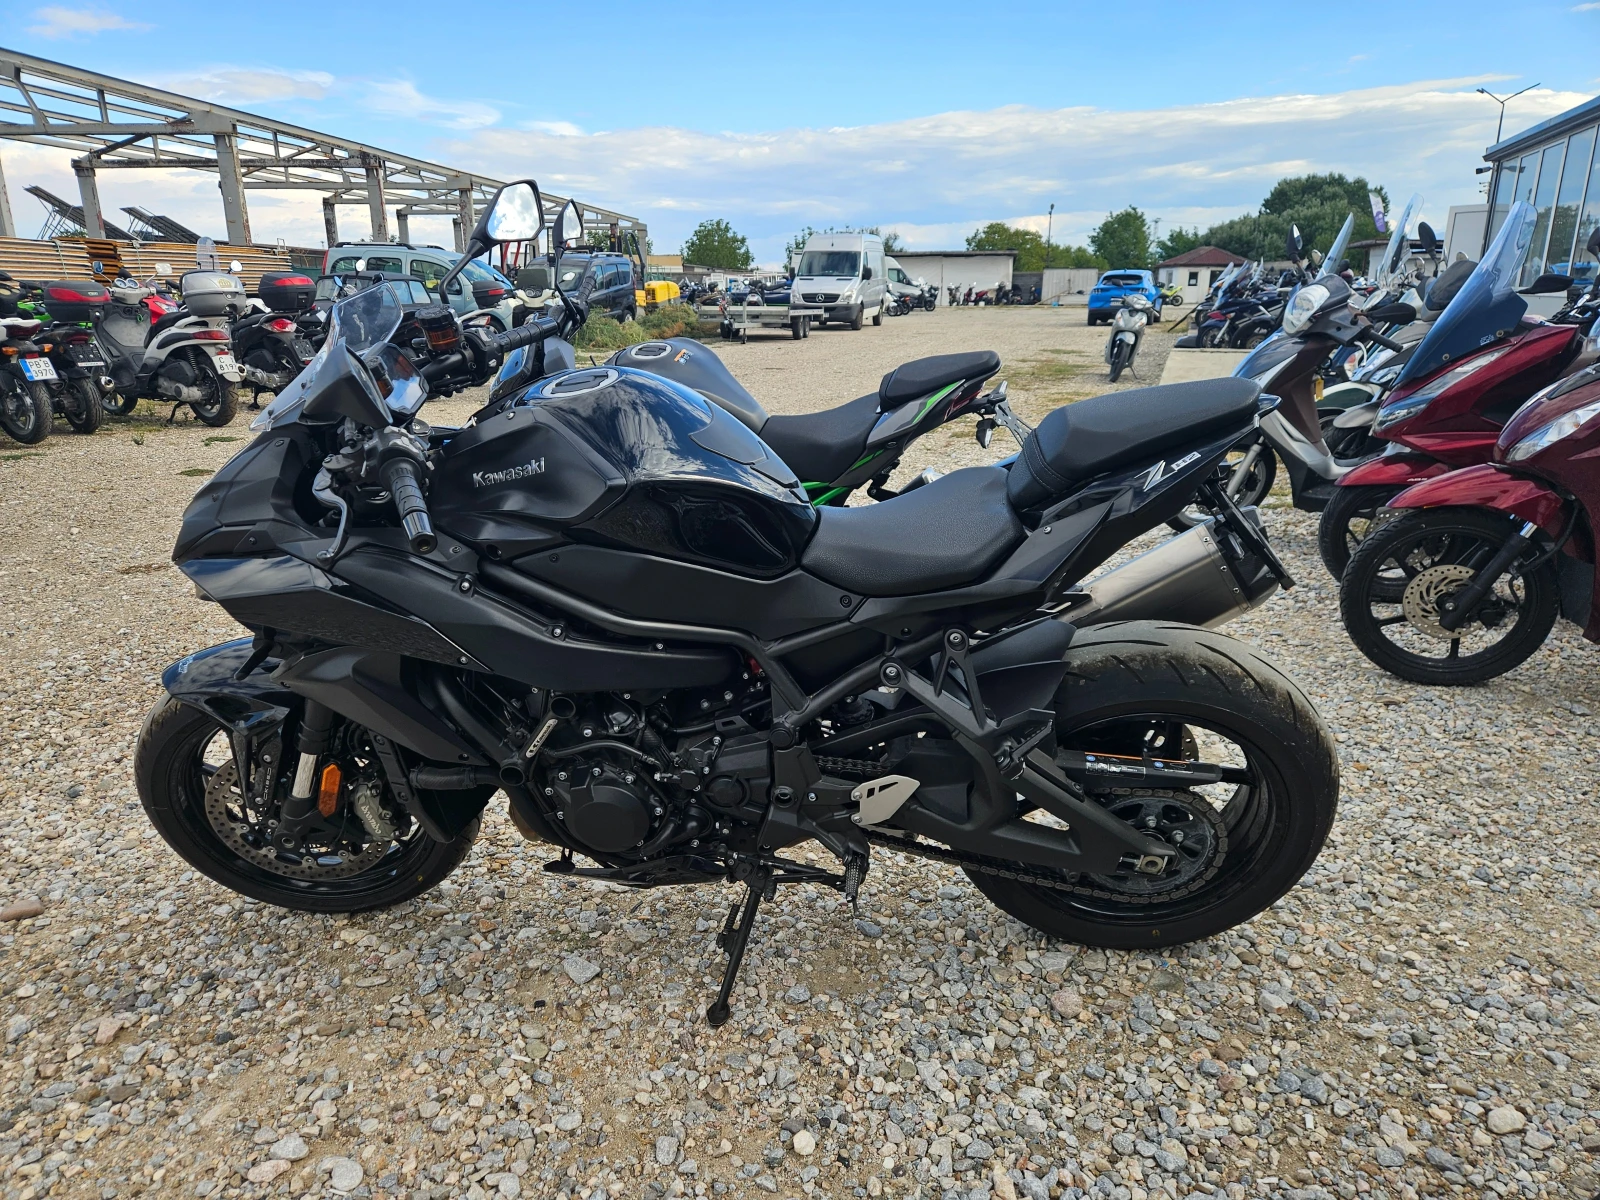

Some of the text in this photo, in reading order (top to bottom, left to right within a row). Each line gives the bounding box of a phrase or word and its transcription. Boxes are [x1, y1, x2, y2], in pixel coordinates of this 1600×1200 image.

[33, 369, 54, 378] 3970
[472, 456, 545, 488] Kawasaki
[361, 805, 382, 834] brembo
